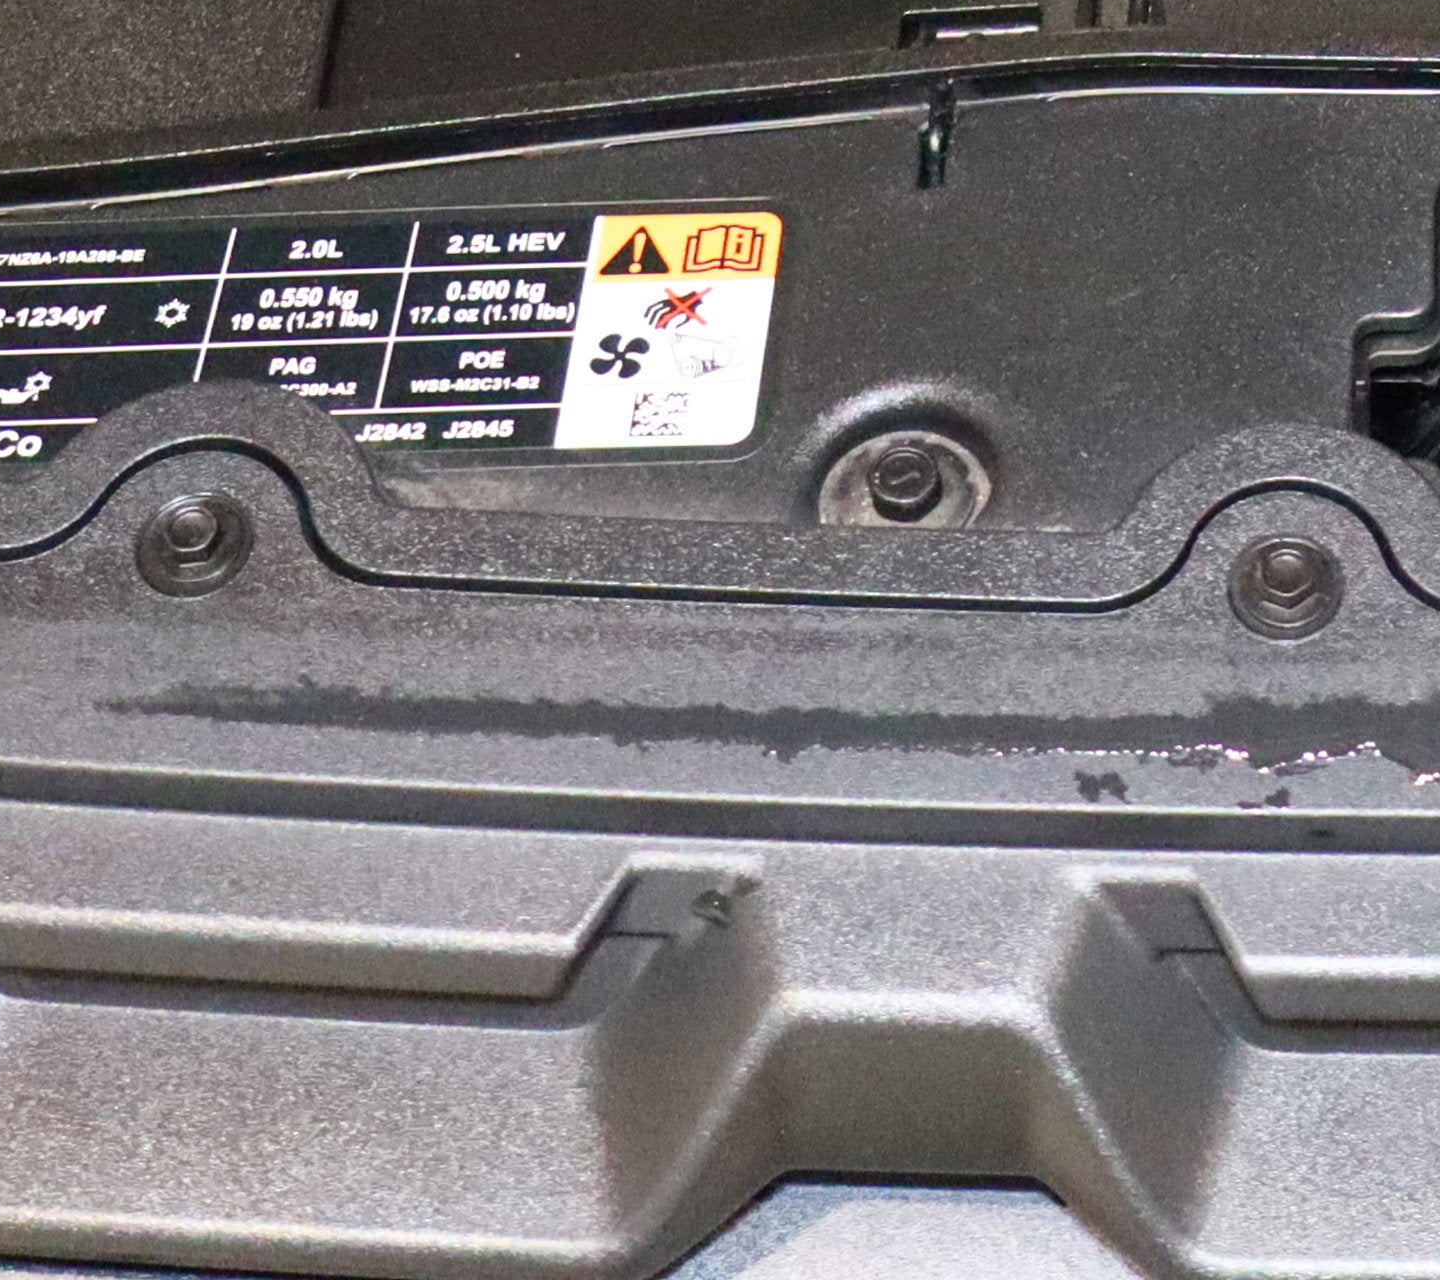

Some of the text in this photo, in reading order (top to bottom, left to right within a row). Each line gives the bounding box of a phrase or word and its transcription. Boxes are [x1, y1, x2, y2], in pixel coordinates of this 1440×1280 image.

[288, 239, 343, 260] 2.0L
[446, 231, 566, 255] 2.5L HEV
[260, 286, 359, 311] 0.550 kg
[446, 280, 546, 304] 0.500 kg
[231, 308, 379, 334] 19 oz (1.21 lbs)
[409, 301, 576, 327] 17.6 oz (1.10 lbs)
[268, 356, 317, 376] PAG
[459, 350, 507, 371] POE
[354, 418, 515, 443] J2842 J2845
